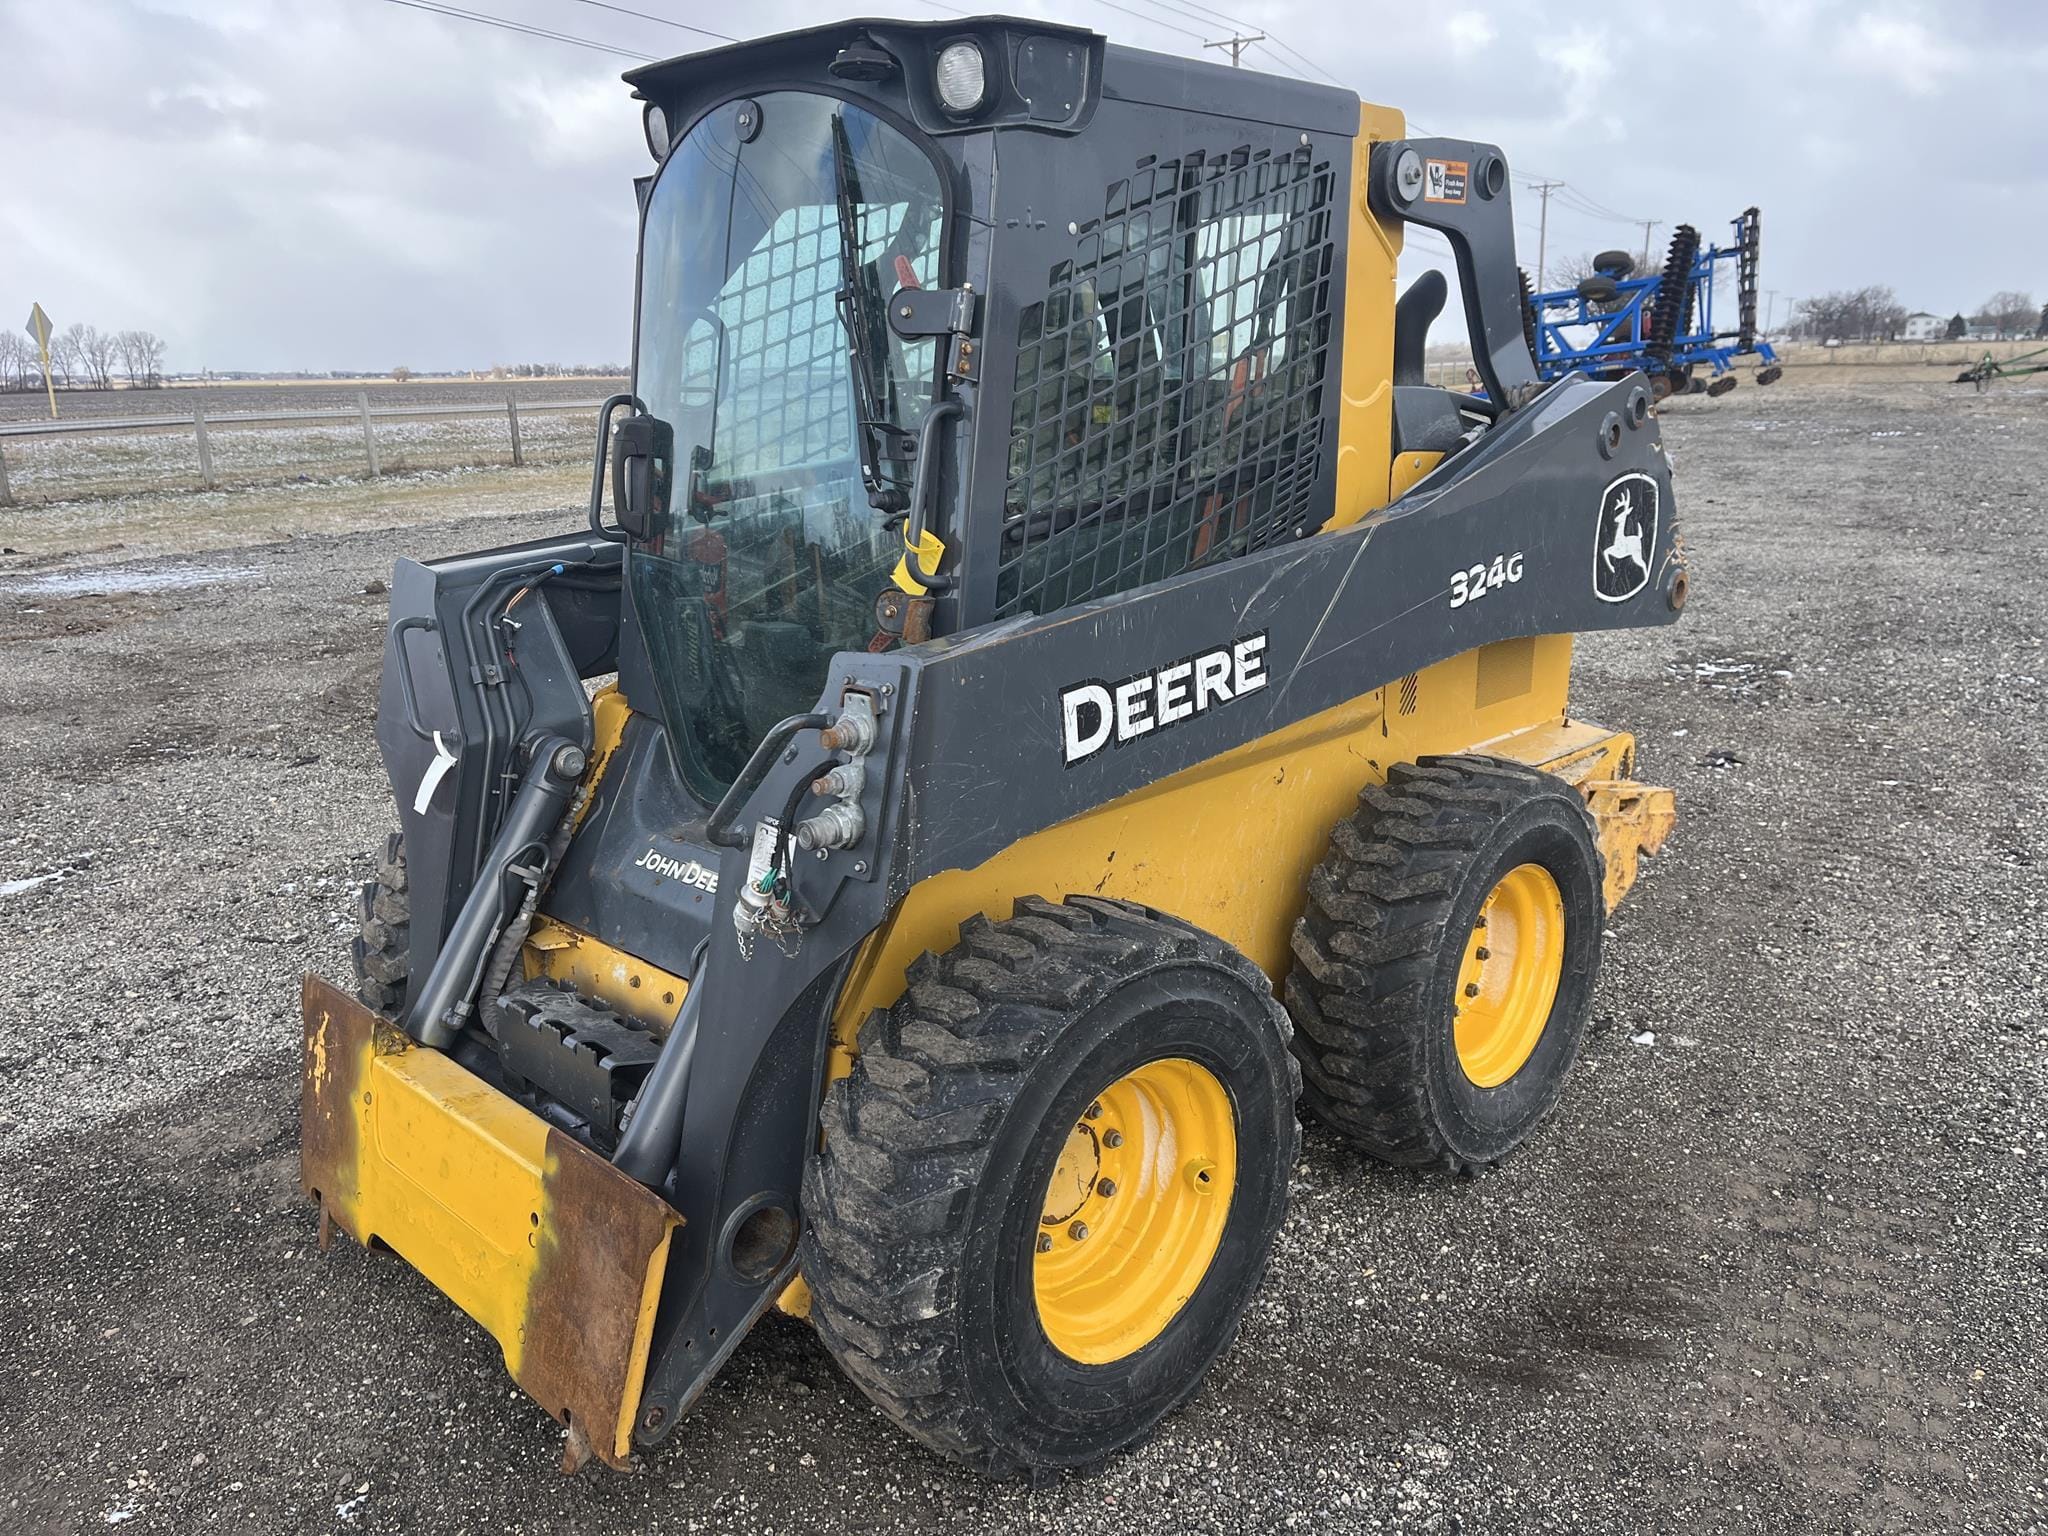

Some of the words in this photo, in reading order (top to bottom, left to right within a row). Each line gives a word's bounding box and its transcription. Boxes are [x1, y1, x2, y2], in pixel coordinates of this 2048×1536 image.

[1449, 551, 1524, 609] 324G
[1062, 633, 1268, 764] DEERE
[634, 847, 685, 880] JOHN
